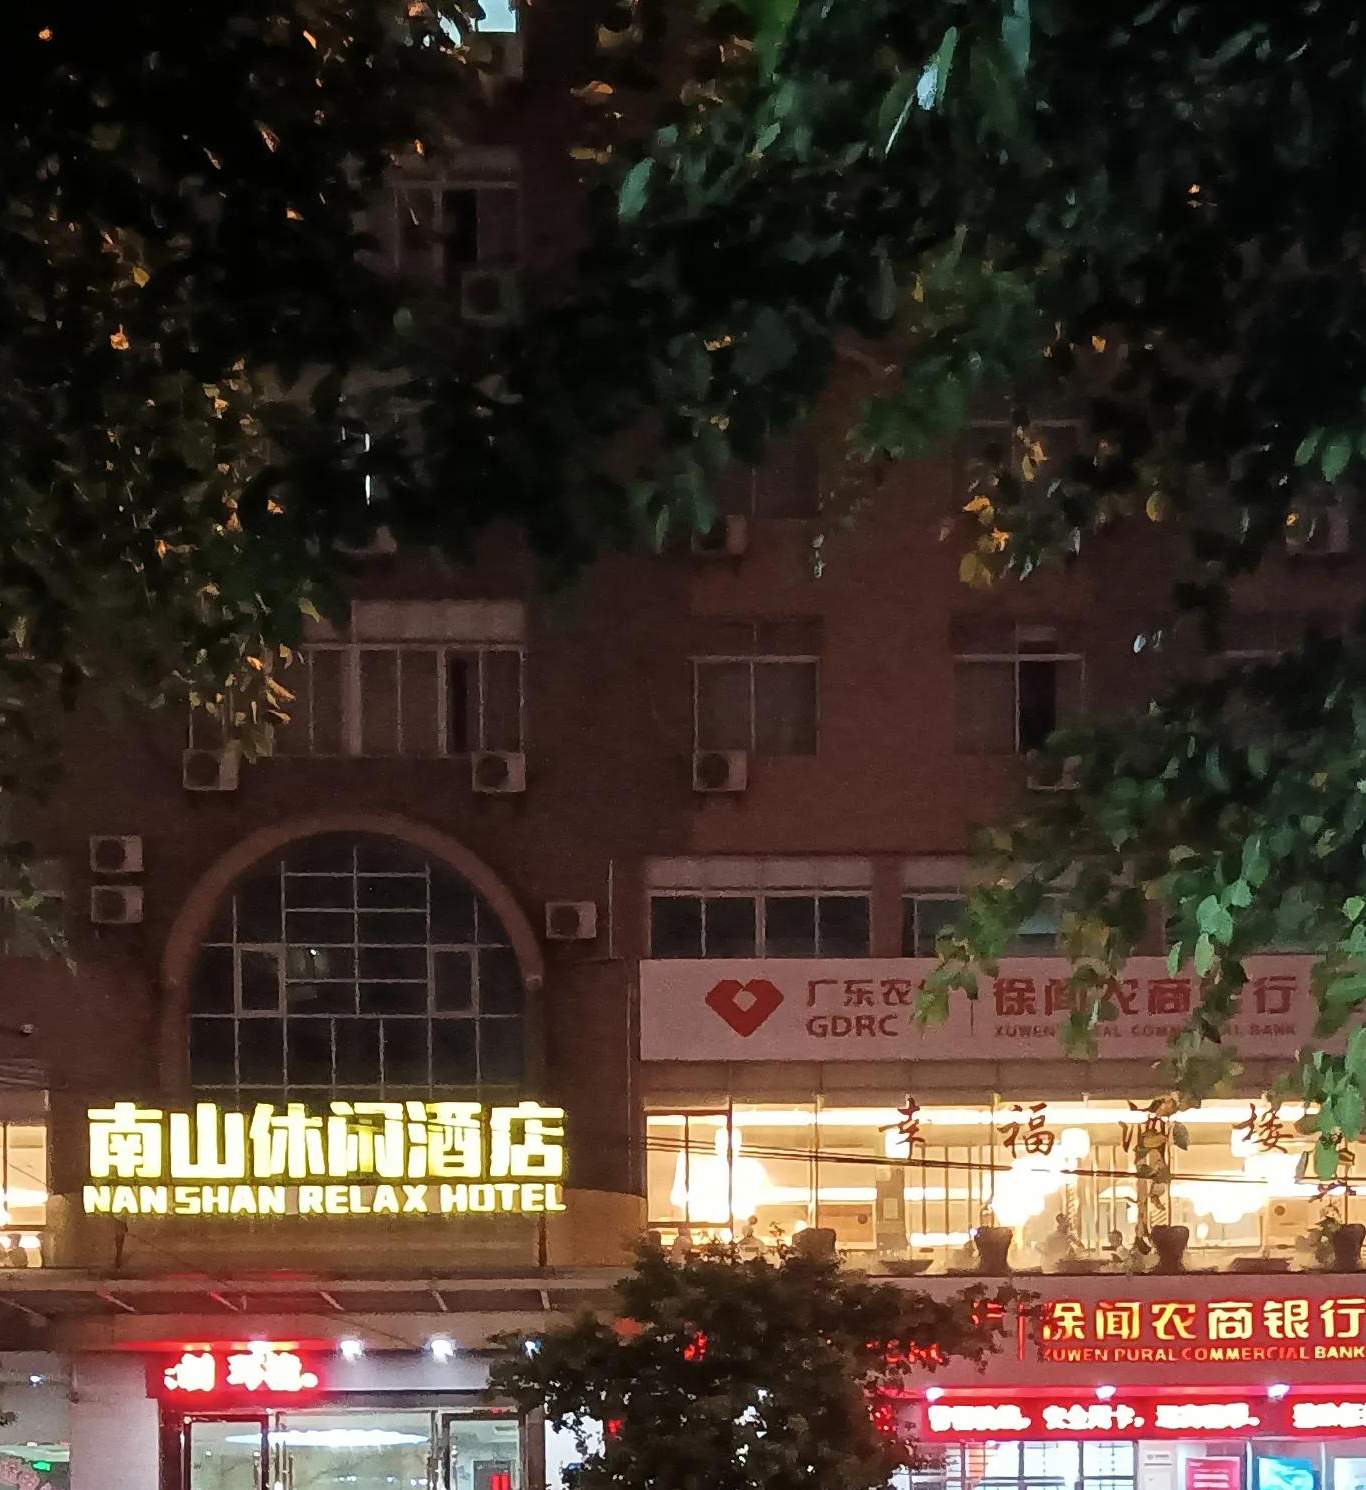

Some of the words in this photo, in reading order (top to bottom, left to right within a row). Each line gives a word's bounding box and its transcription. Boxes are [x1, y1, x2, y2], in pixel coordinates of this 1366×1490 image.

[807, 978, 926, 1008] 广东农
[993, 976, 1298, 1017] 徐闻农商行
[805, 1013, 899, 1038] GDRC
[87, 1101, 566, 1178] 南山休闲酒店
[83, 1185, 167, 1214] NAN
[174, 1184, 286, 1214] SHAN
[298, 1184, 428, 1213] RELAX
[439, 1182, 567, 1212] HOTEL
[1182, 1346, 1310, 1361] COMMERCIAL
[1314, 1345, 1366, 1360] BANK
